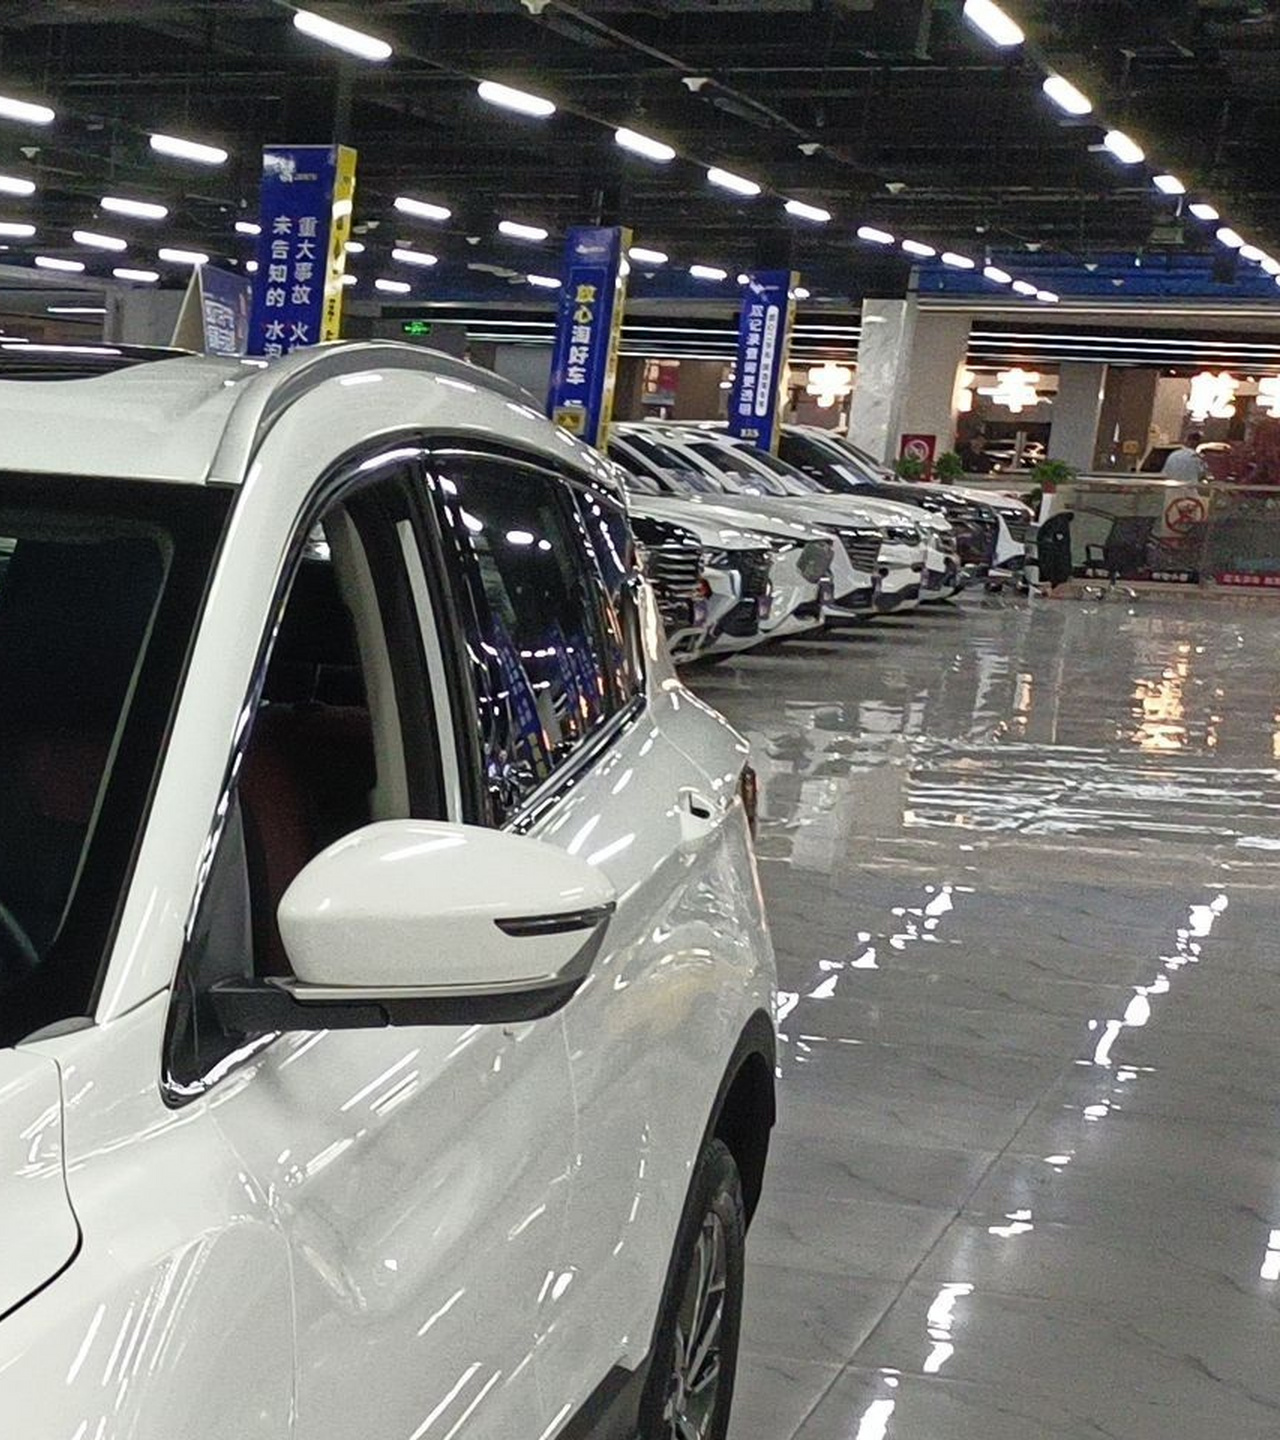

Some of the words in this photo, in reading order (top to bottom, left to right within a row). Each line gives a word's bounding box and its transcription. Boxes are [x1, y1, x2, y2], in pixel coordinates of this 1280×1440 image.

[265, 215, 292, 308] 未告知的
[291, 216, 319, 305] 重大事故
